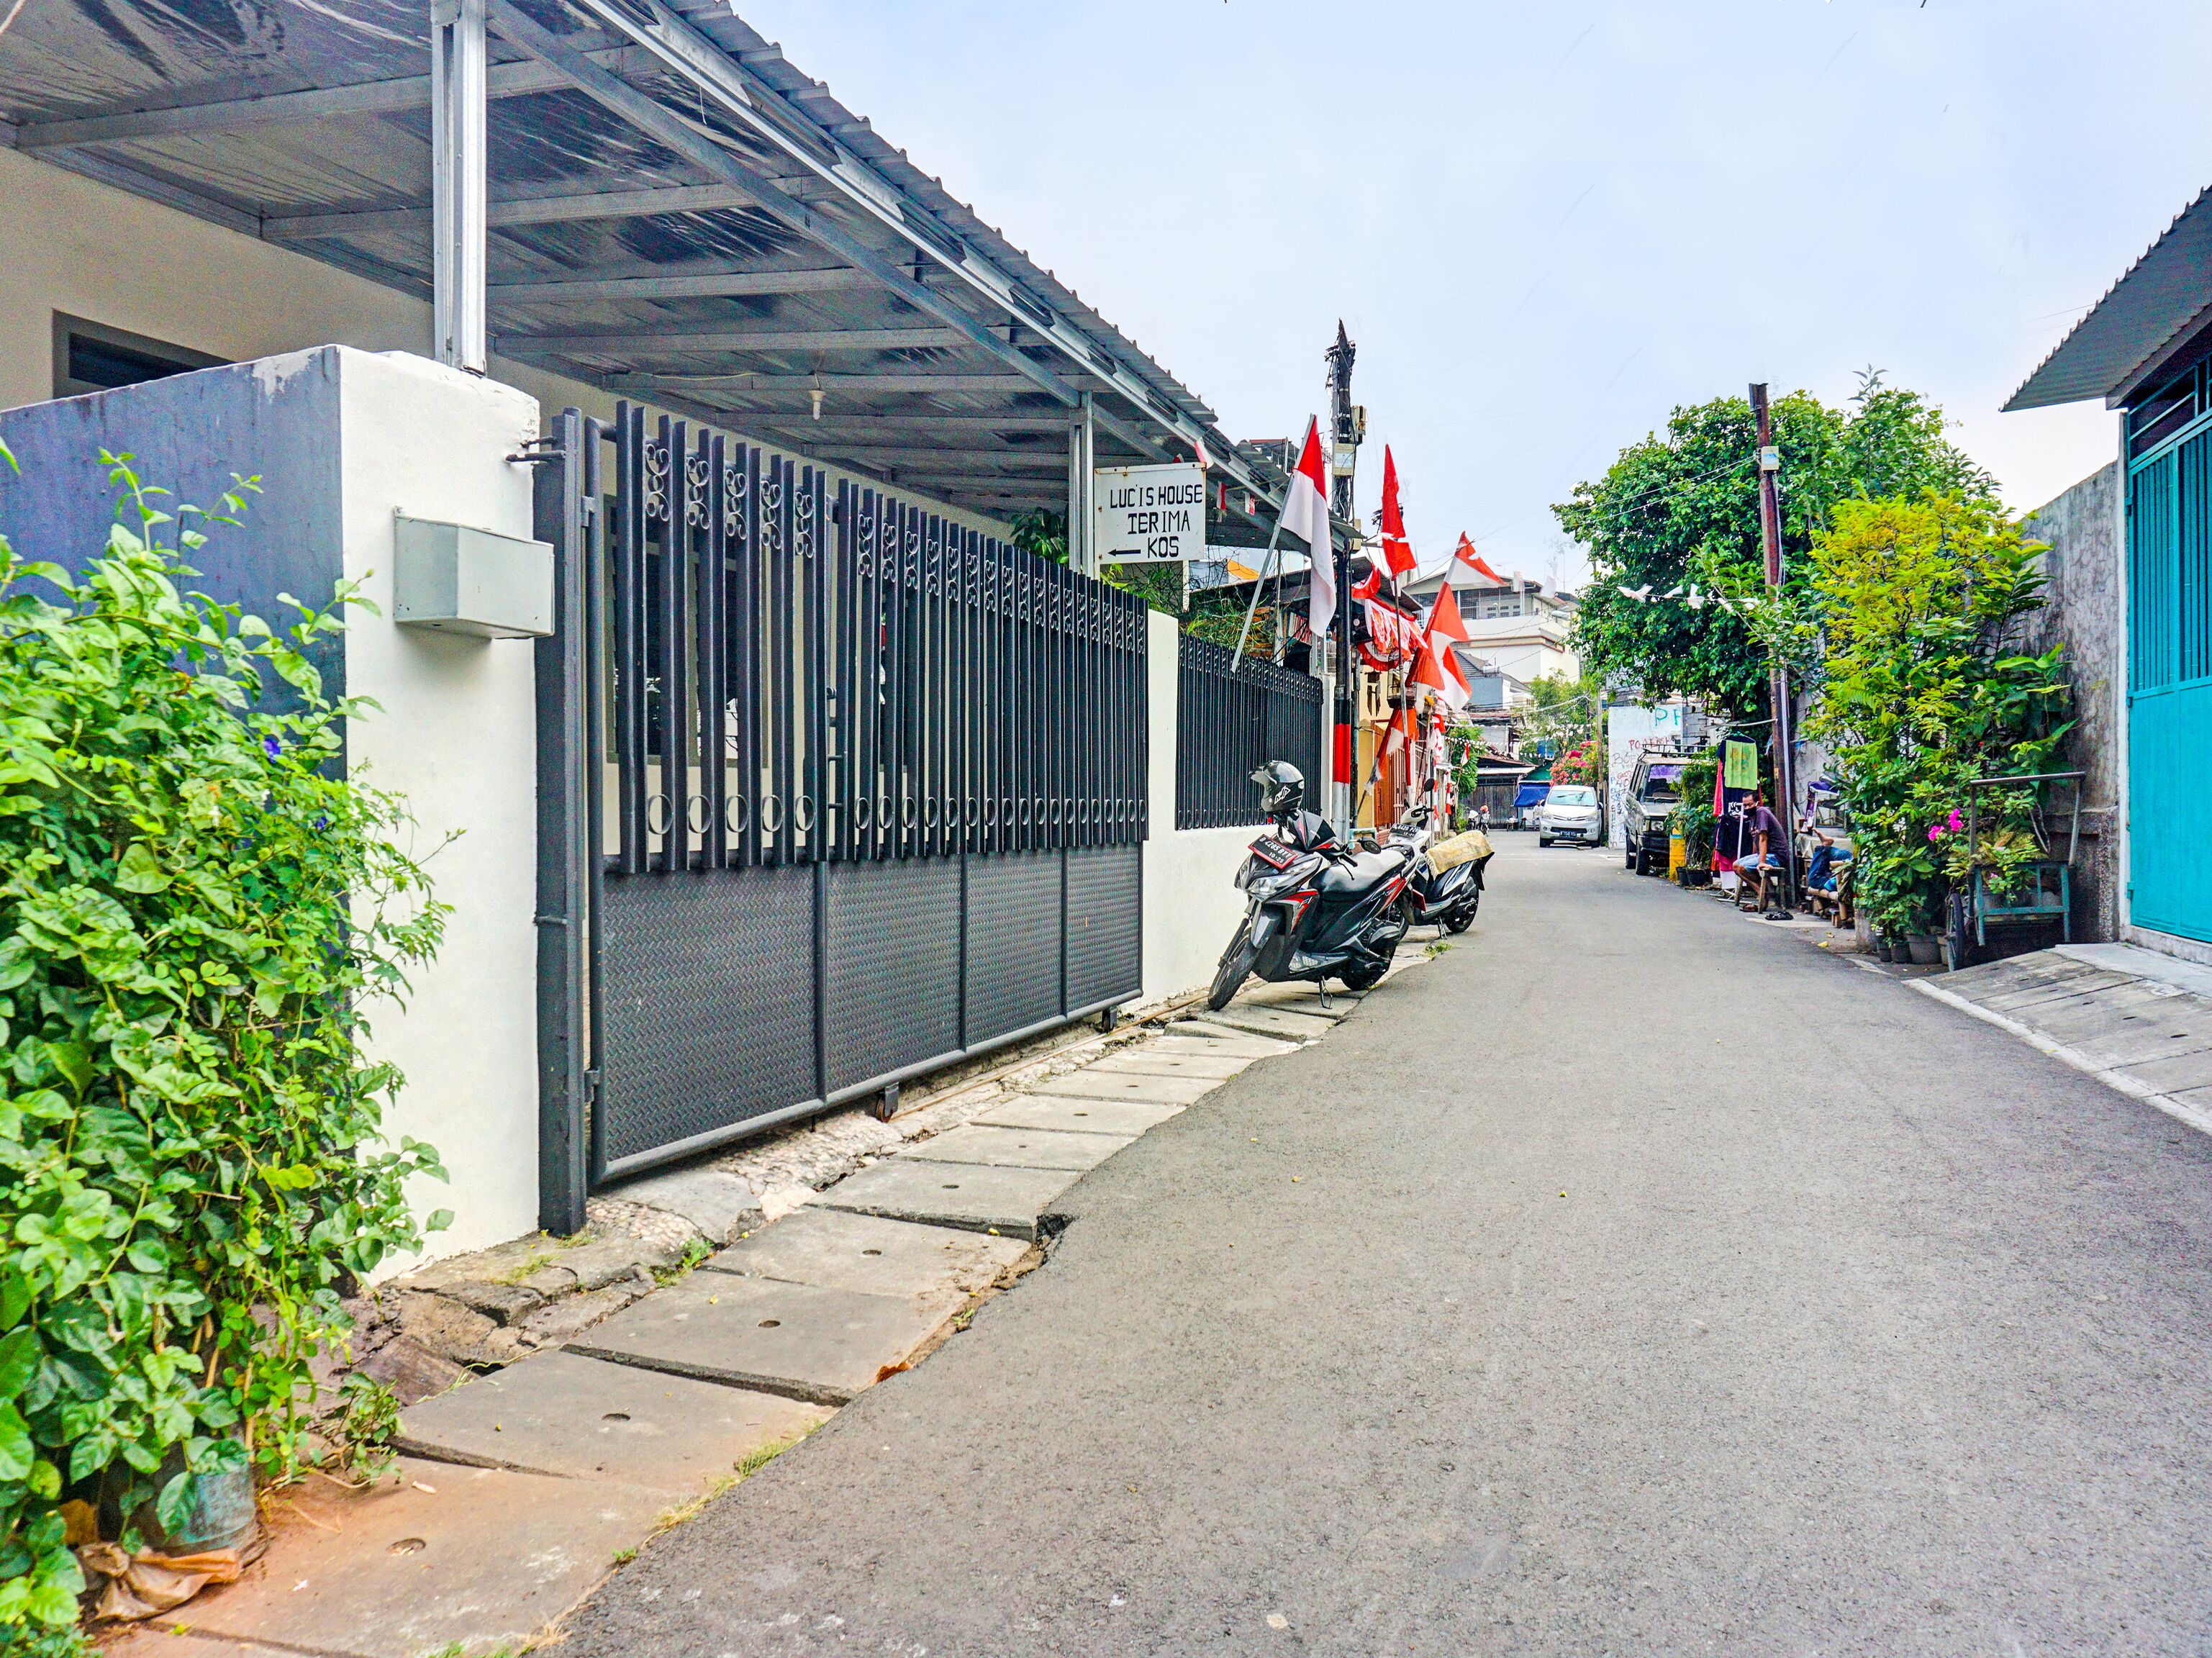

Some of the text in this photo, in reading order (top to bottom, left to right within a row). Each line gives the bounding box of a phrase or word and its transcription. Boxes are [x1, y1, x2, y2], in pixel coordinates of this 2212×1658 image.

[1158, 484, 1202, 506] HOUSE
[1128, 509, 1191, 535] TERIMA
[1147, 535, 1179, 558] KOS
[1264, 841, 1281, 851] 4285
